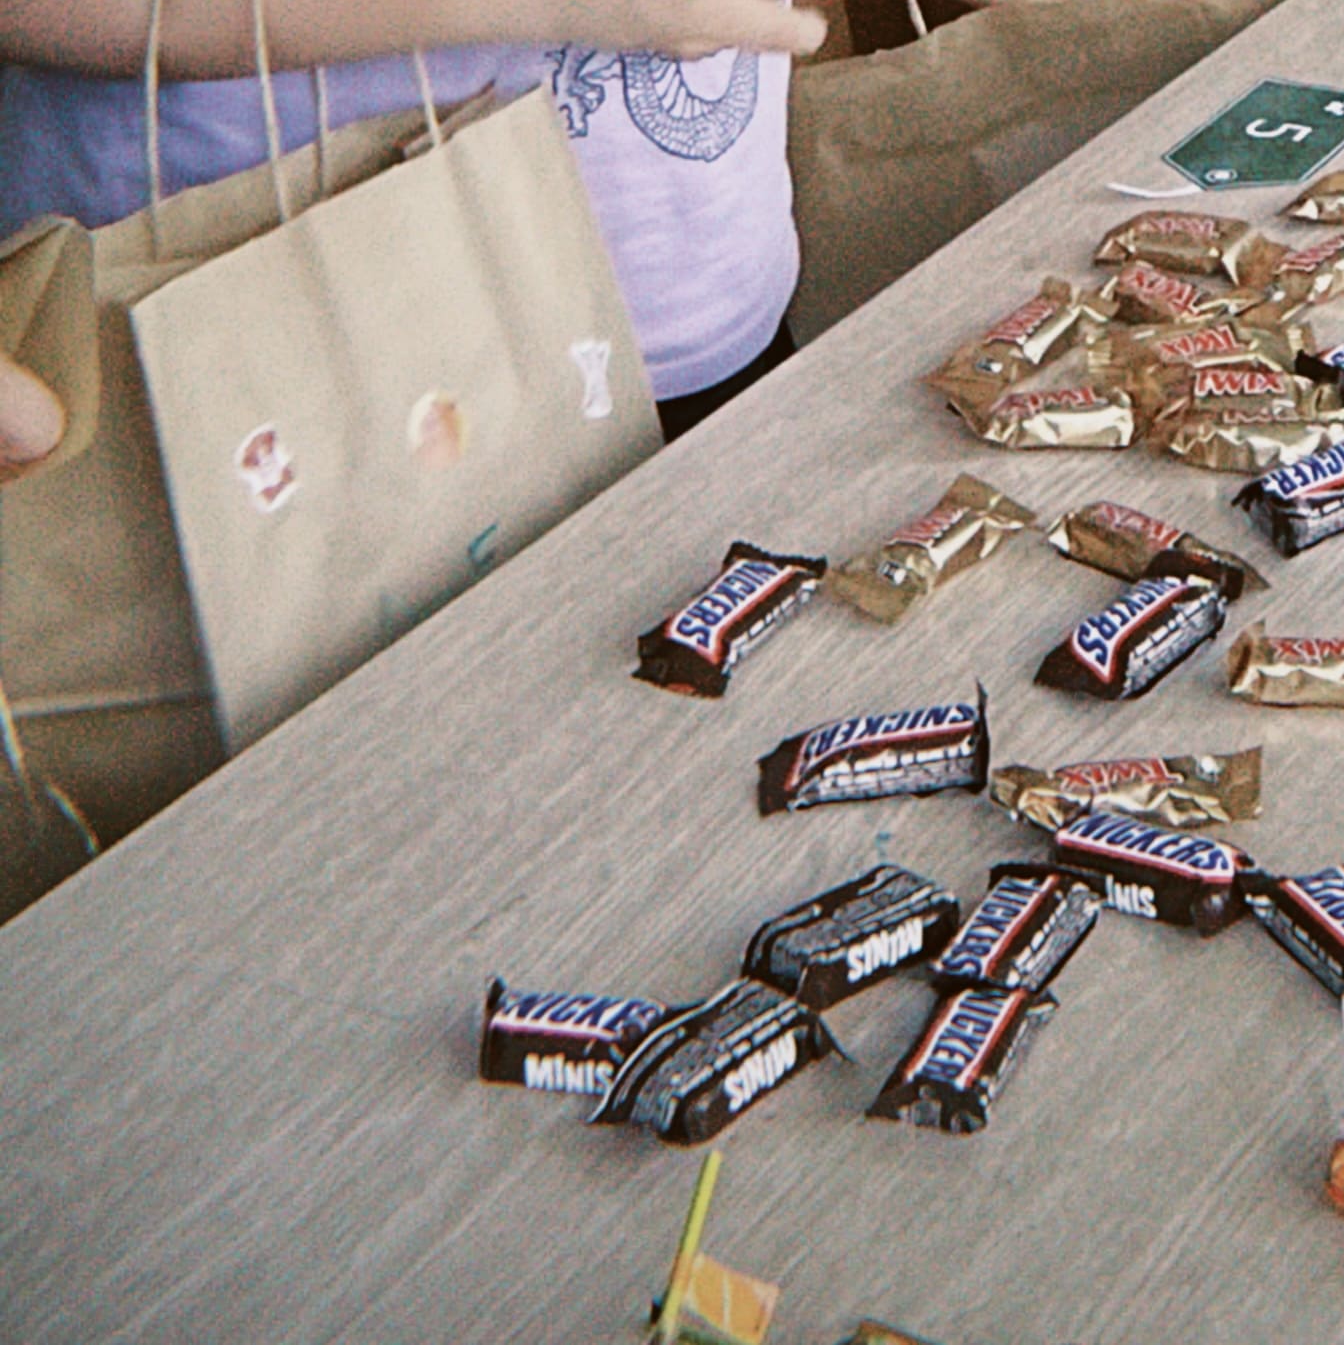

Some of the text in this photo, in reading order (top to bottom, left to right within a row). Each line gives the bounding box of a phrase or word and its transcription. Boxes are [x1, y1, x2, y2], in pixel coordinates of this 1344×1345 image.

[1246, 117, 1312, 144] 5
[1195, 368, 1286, 398] TWIX
[674, 561, 780, 649] NICKERS
[1076, 578, 1182, 667] NICKERS
[1068, 813, 1230, 871] NICKERS
[846, 916, 924, 983] MINIS
[940, 877, 1041, 980] NICKERS
[723, 1031, 798, 1113] MINIS
[920, 988, 1009, 1084] NICKER
